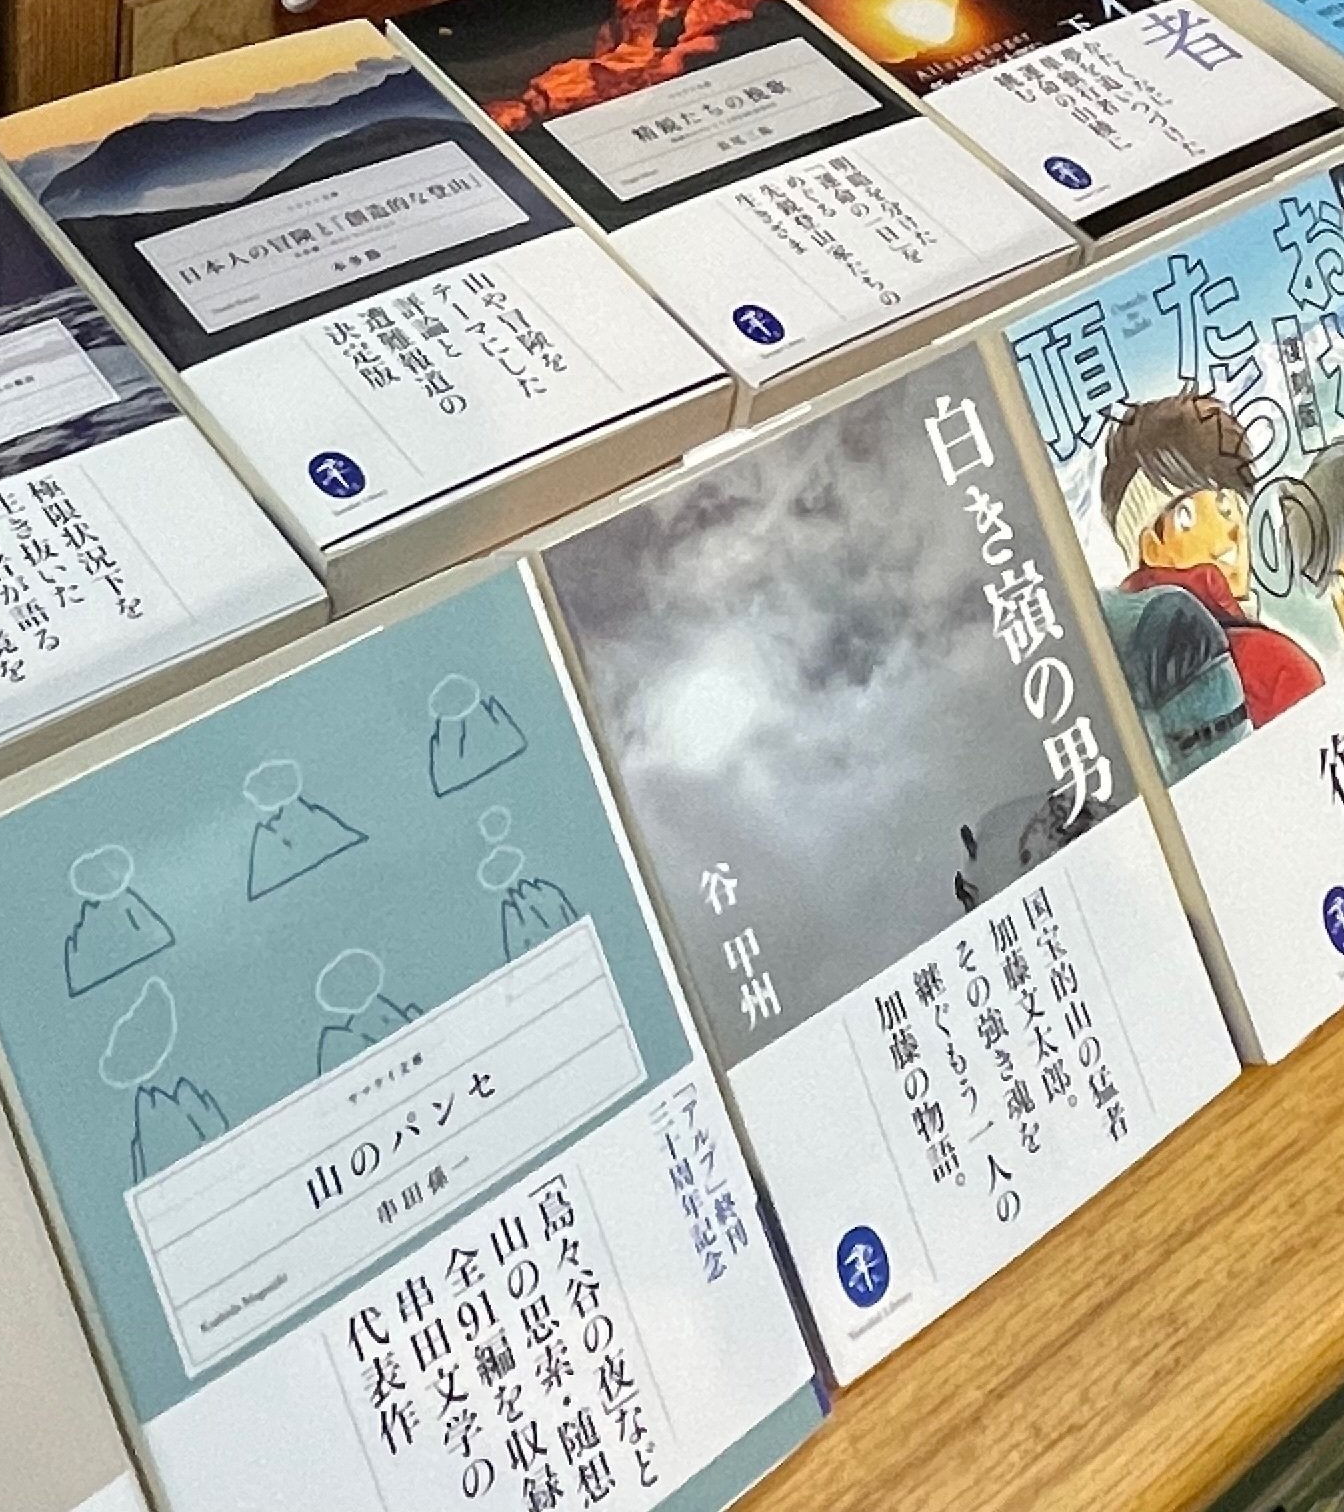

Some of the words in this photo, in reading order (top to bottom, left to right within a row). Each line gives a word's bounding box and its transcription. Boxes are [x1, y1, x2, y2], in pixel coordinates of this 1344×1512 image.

[324, 321, 401, 389] 決定版
[358, 306, 467, 414] 遭難報道の
[395, 292, 462, 358] 評論と
[432, 282, 547, 398] テーマにした
[461, 272, 567, 372] 山や冒険を
[1014, 300, 1132, 462] 頂
[1151, 252, 1331, 598] たちの
[26, 479, 143, 619] 極限状況下を
[923, 391, 1115, 824] 白き嶺の男
[699, 863, 739, 914] 谷
[722, 928, 781, 1029] 甲州
[988, 913, 1077, 1107] 加藤文太郎。
[1021, 885, 1127, 1142] 国宝的山の猛者
[874, 990, 965, 1186] 加藤の物語。
[912, 962, 1020, 1222] 継ぐもう一人の
[955, 939, 1040, 1154] その強き魂を
[306, 1072, 495, 1209] 山のパンセ
[376, 1154, 470, 1224] 串田孫一
[658, 1100, 727, 1283] 三十周年記念
[672, 1081, 748, 1255] 「アルプ」終刊
[348, 1306, 420, 1455] 代表作
[395, 1275, 495, 1498] 串田文学の
[444, 1248, 564, 1512] 全91編を収録
[489, 1215, 615, 1509] 山の思索・随想
[528, 1173, 658, 1487] 「島々谷の夜」など
